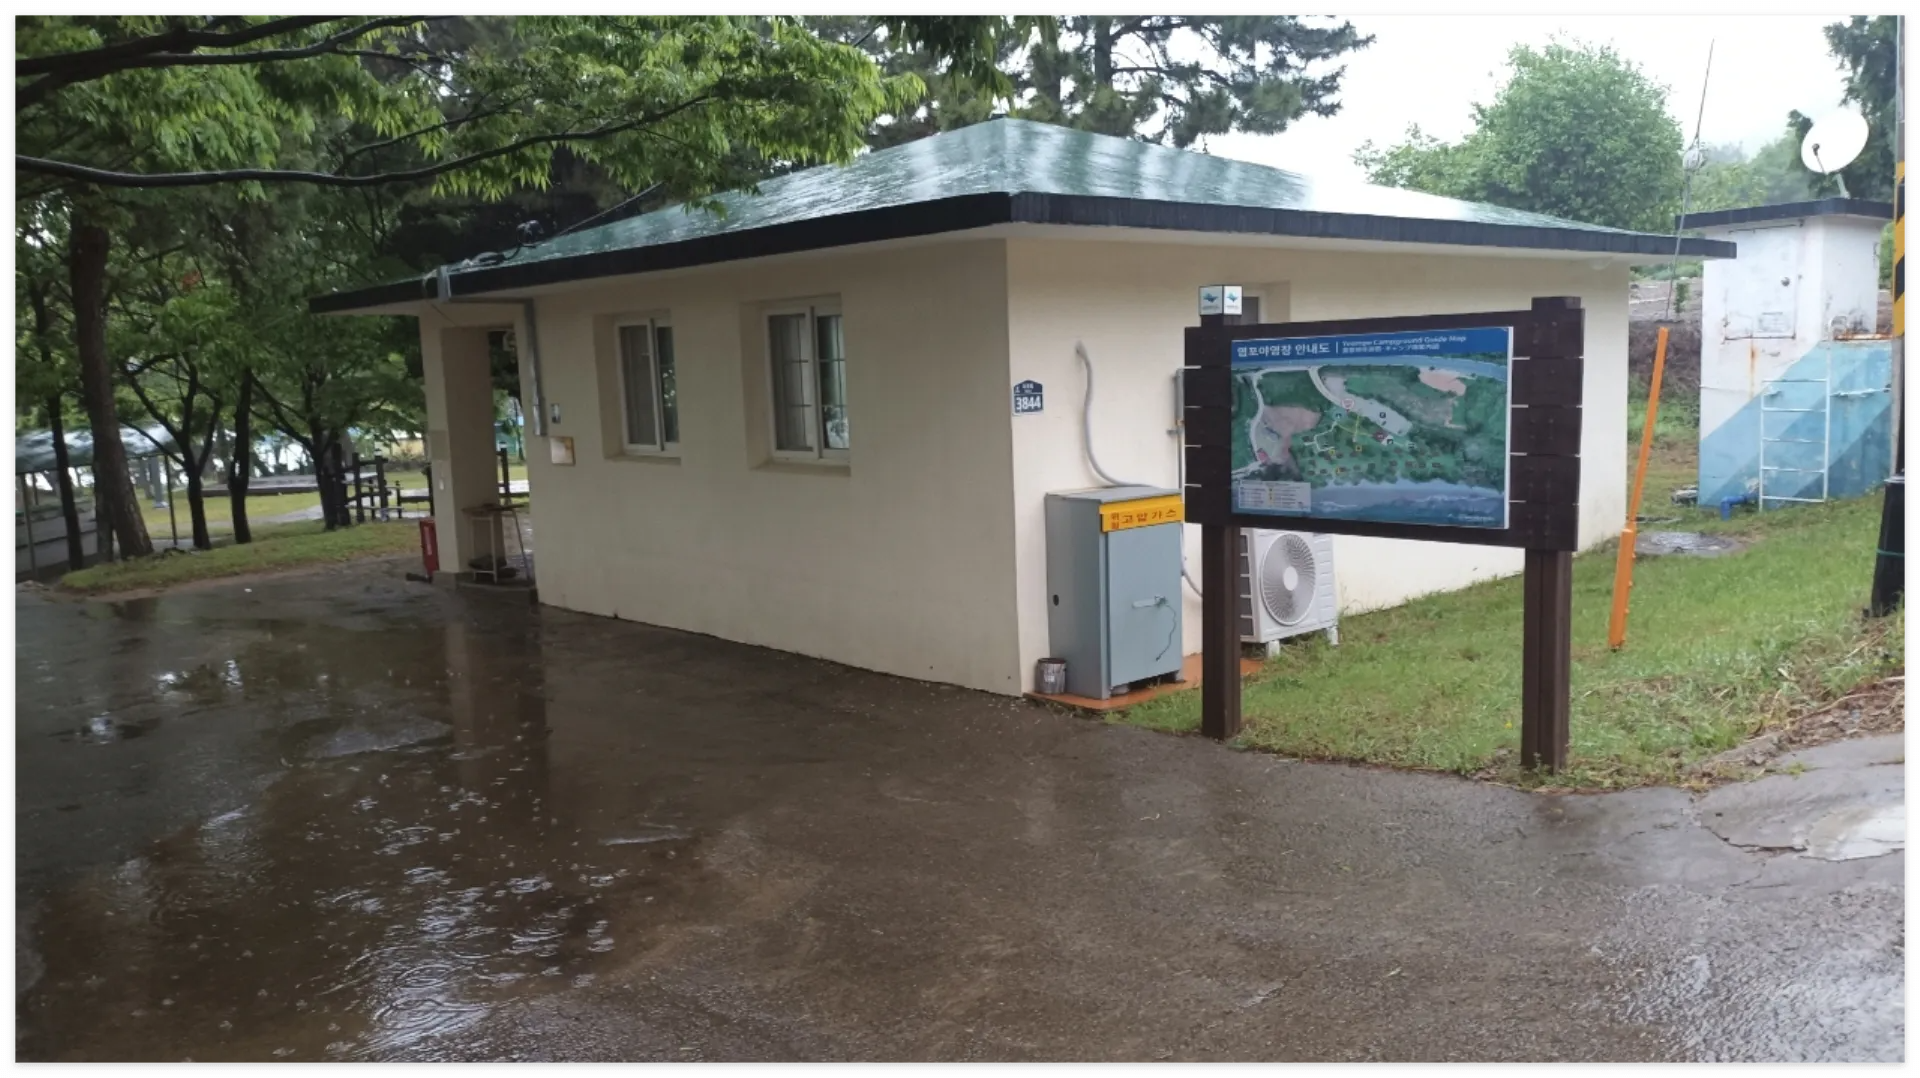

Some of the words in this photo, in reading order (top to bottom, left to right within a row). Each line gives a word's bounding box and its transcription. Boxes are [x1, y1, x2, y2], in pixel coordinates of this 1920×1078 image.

[1373, 337, 1423, 346] Campground
[1424, 335, 1448, 343] Guide
[1448, 335, 1467, 343] Map
[1295, 342, 1331, 355] 안내도
[1016, 396, 1041, 410] 3844
